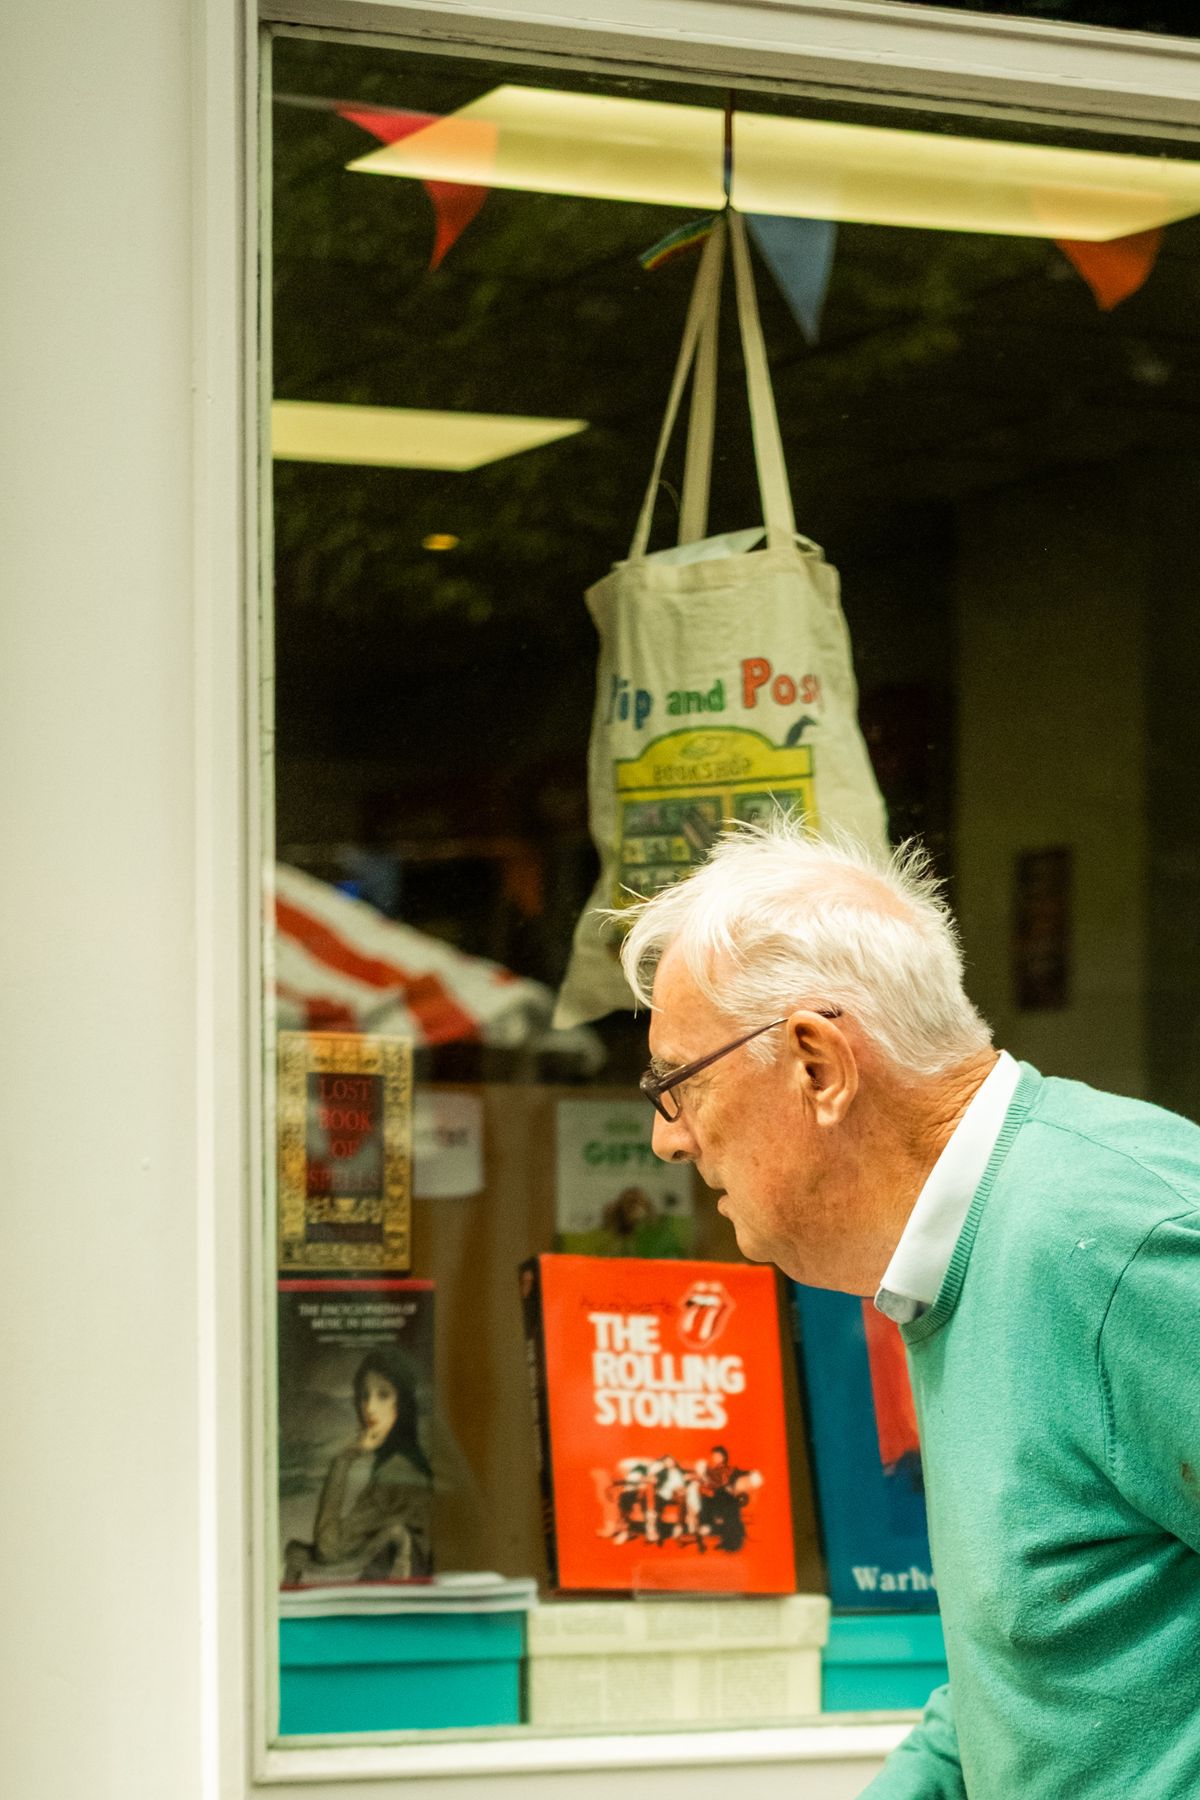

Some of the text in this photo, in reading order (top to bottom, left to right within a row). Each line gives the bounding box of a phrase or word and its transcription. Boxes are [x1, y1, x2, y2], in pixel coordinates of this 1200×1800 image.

[666, 680, 726, 716] and
[321, 1078, 372, 1101] LOST
[319, 1109, 373, 1132] BOOK
[330, 1140, 360, 1160] OF
[588, 1312, 662, 1353] THE
[592, 1352, 746, 1394] ROLLING
[594, 1389, 728, 1430] STONES
